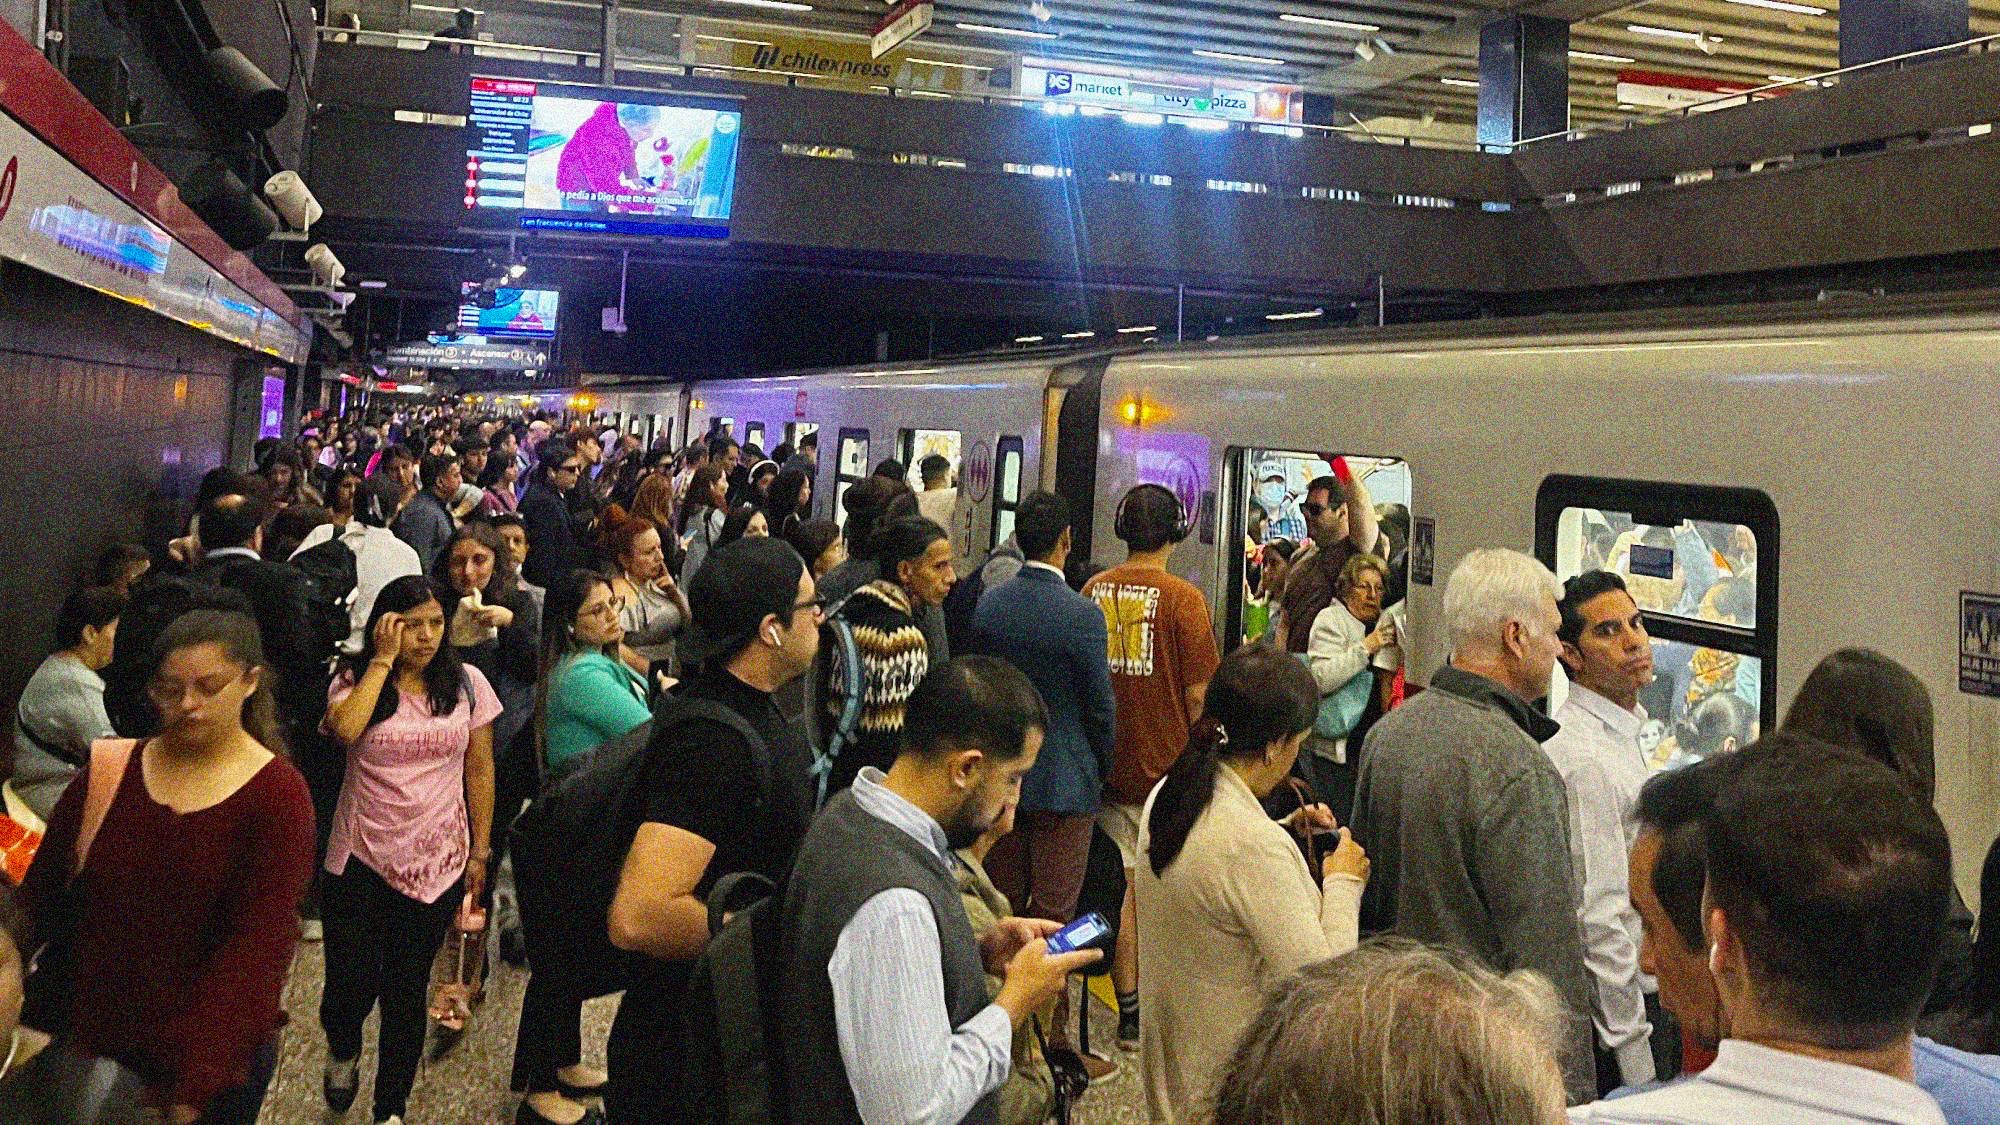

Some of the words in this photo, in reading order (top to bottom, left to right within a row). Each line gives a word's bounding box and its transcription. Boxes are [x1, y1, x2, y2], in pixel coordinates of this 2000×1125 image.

[782, 49, 892, 78] chilexpress
[1075, 83, 1122, 96] market
[1211, 94, 1246, 109] pizza
[598, 191, 615, 202] Dios
[616, 194, 632, 204] que
[470, 349, 510, 358] Ascensor
